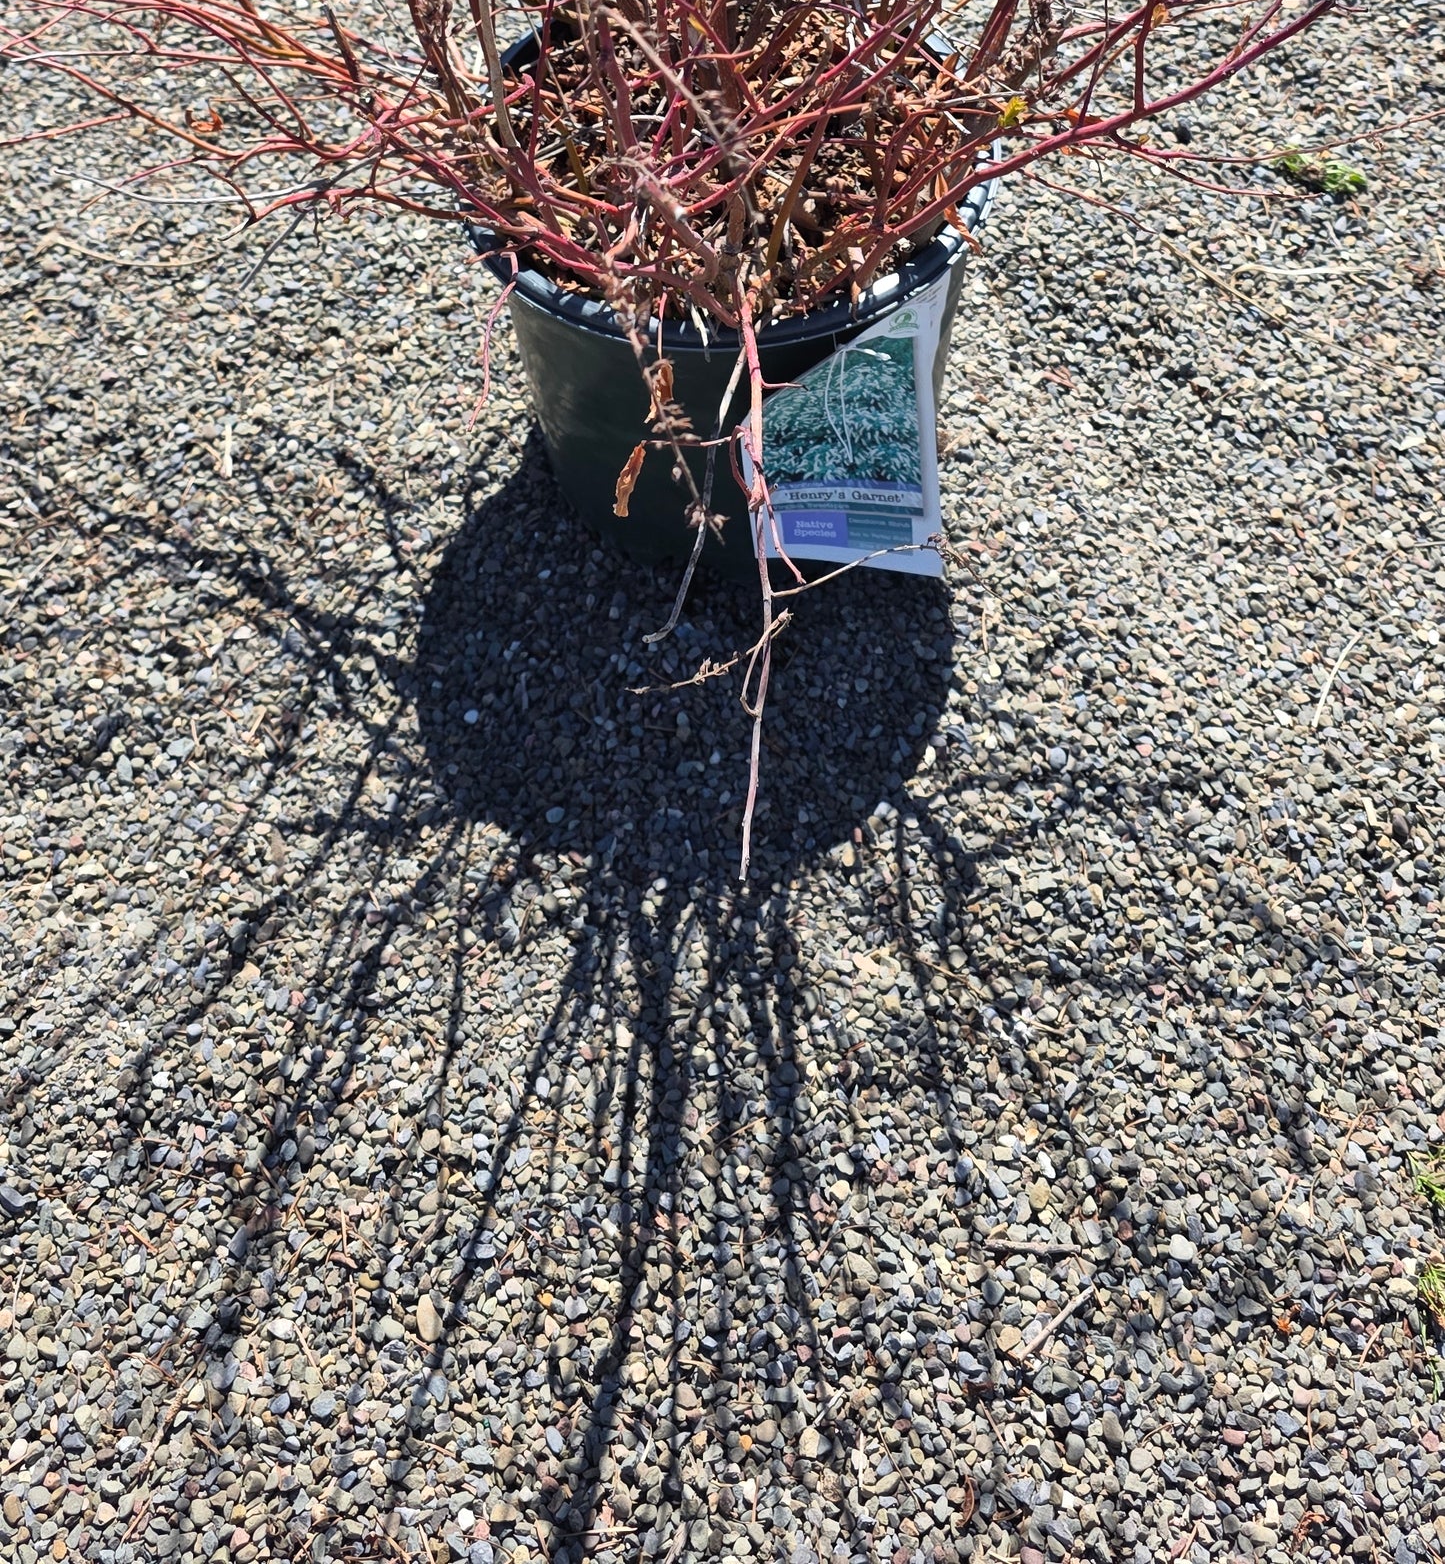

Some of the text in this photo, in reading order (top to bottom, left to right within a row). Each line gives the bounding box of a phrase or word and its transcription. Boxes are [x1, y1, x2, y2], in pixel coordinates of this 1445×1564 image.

[784, 490, 905, 503] 'Henry's Garnet'
[795, 520, 834, 530] Native
[793, 529, 837, 539] Species
